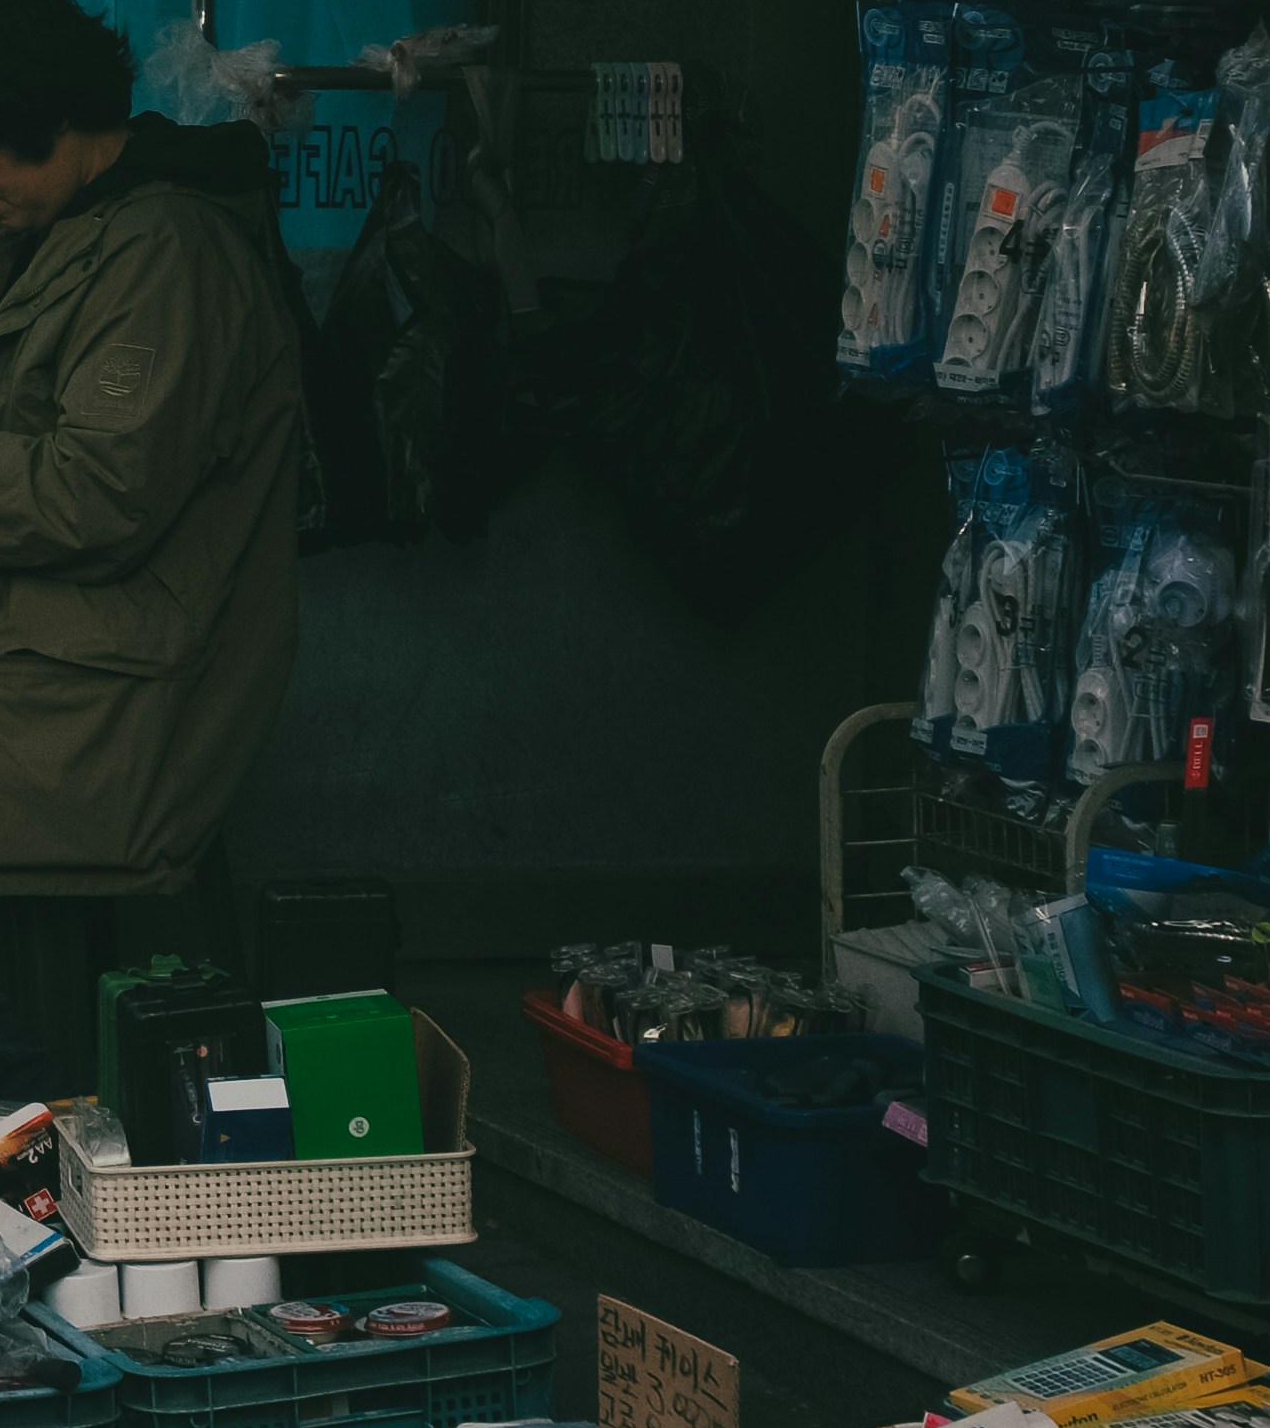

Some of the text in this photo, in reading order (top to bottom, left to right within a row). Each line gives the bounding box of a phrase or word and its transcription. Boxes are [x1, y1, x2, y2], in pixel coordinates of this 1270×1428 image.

[599, 1305, 728, 1411] 담배 케이스
[1199, 1363, 1237, 1385] HT-305
